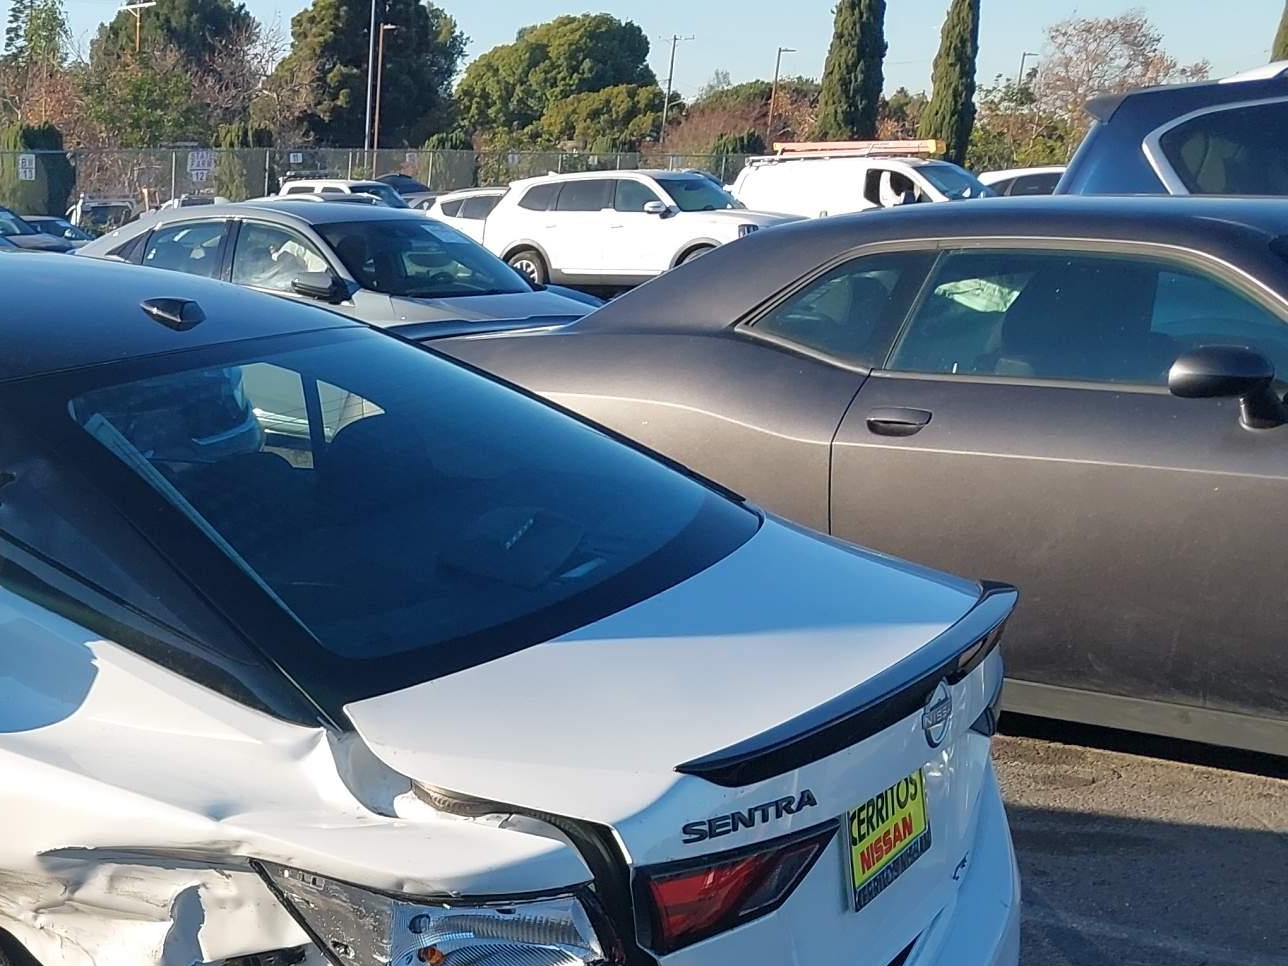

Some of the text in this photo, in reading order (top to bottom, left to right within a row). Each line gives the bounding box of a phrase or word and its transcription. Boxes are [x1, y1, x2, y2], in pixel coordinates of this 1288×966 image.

[195, 170, 208, 181] 12
[681, 789, 818, 845] SENTRA
[849, 773, 918, 846] CERRITOS
[859, 812, 914, 875] NISSAN
